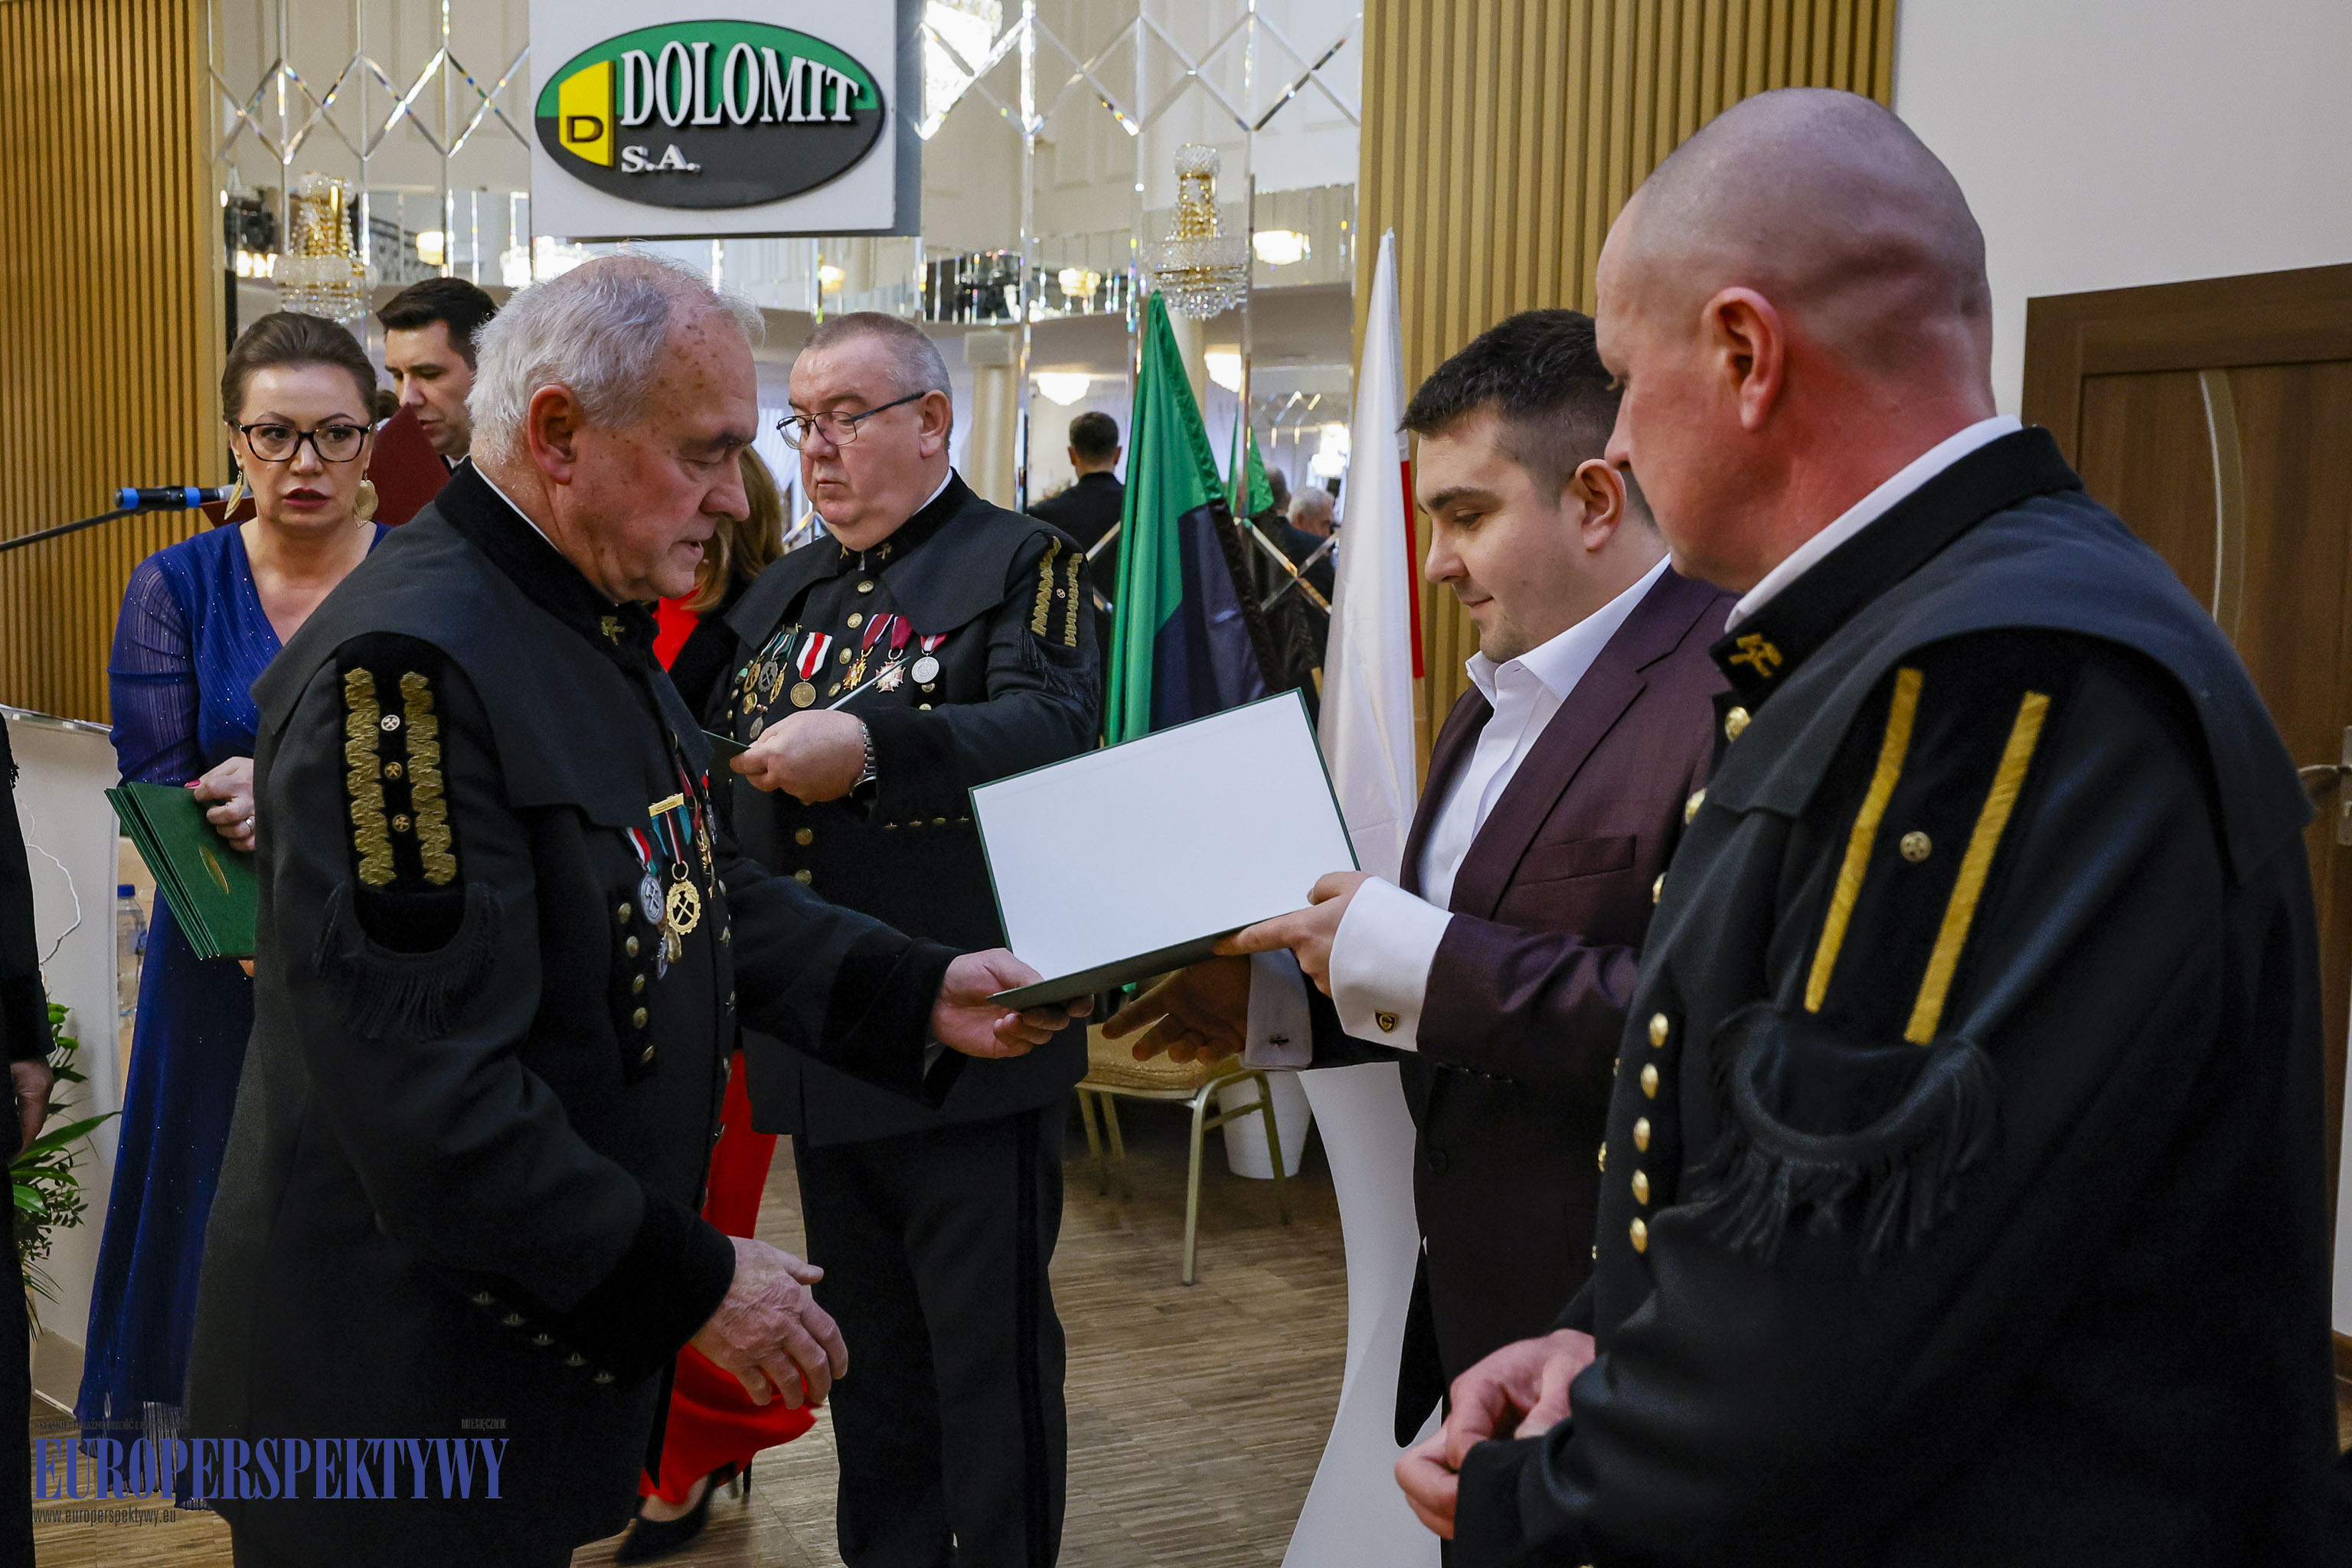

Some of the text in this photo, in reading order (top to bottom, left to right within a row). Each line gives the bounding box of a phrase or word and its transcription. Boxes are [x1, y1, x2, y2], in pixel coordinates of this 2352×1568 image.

[619, 40, 860, 128] DOLOMIT
[567, 115, 604, 143] D
[621, 143, 701, 173] S.A.
